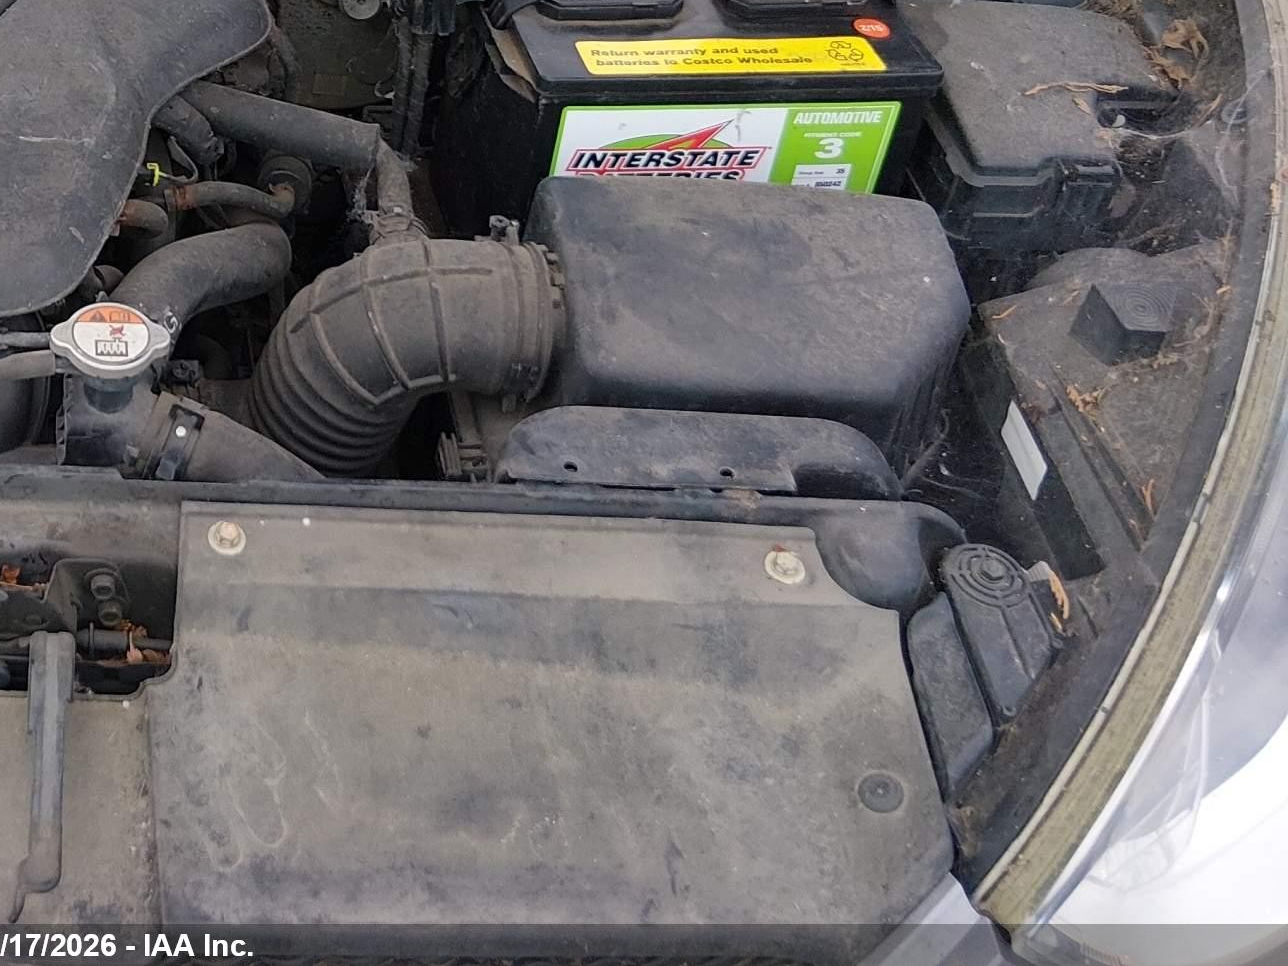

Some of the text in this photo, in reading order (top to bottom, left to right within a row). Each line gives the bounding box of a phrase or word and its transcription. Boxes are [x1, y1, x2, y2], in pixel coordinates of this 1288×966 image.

[590, 47, 778, 57] Return warranty and used
[596, 56, 813, 66] batteries to Costco Wholesale
[793, 111, 884, 124] AUTOMOTIVE
[814, 137, 844, 159] 3
[571, 150, 758, 170] INTERSTATE
